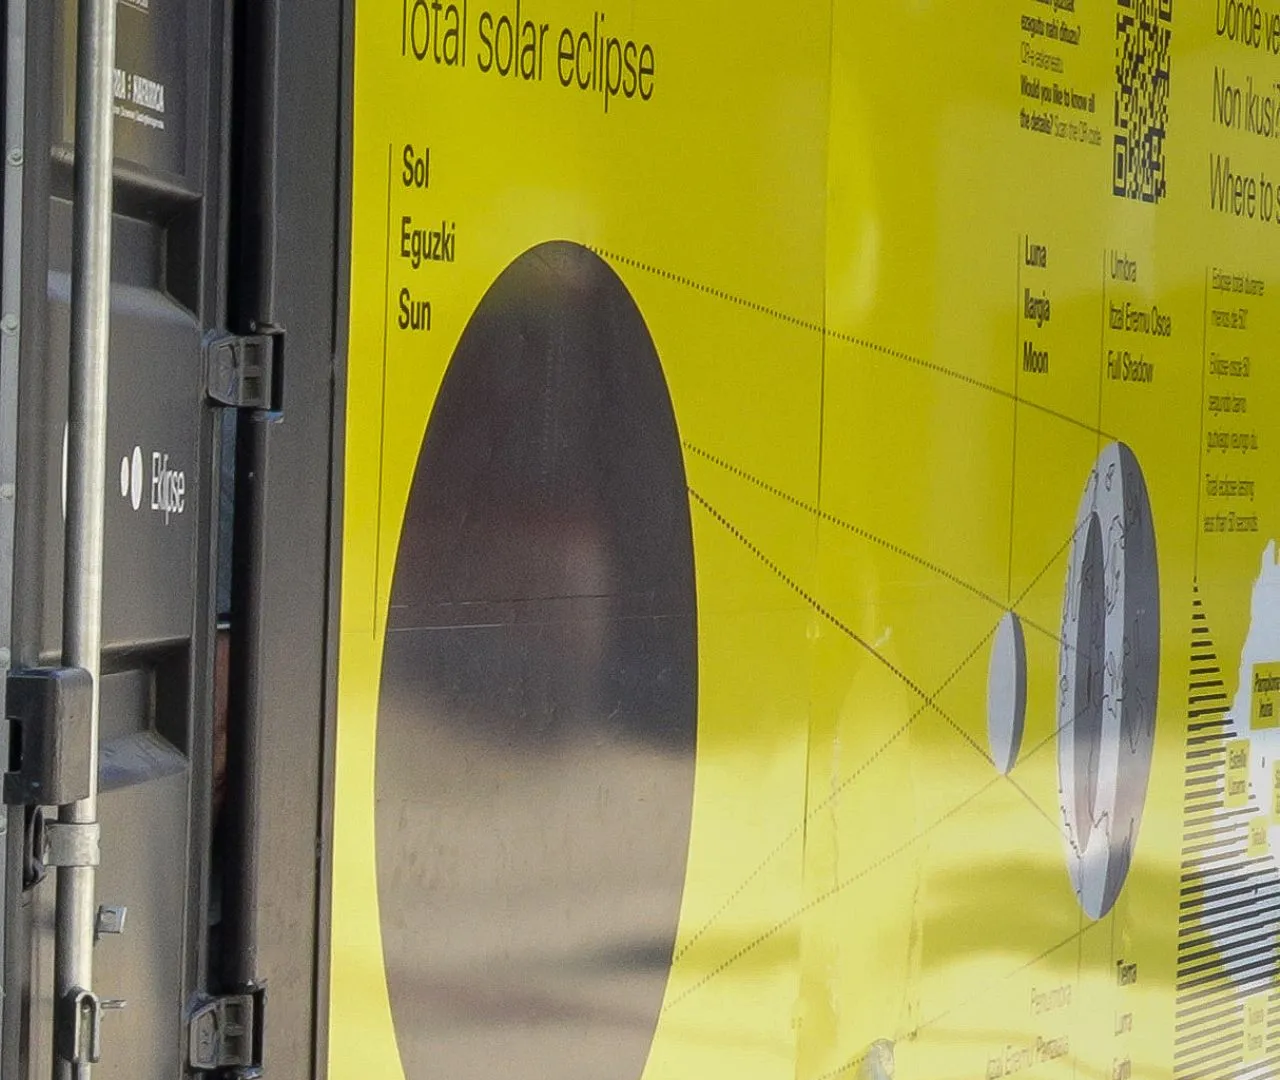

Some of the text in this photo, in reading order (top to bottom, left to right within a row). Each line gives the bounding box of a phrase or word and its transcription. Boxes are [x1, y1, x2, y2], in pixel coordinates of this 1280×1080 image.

[477, 0, 549, 81] solar
[557, 11, 654, 114] eclipse
[1212, 66, 1242, 129] Non
[402, 144, 430, 188] Sol
[1210, 152, 1256, 219] Where
[1260, 171, 1274, 222] to
[400, 216, 456, 269] Eguzki
[398, 287, 431, 331] Sun
[1023, 341, 1048, 374] Moon
[151, 452, 185, 525] Eklipse
